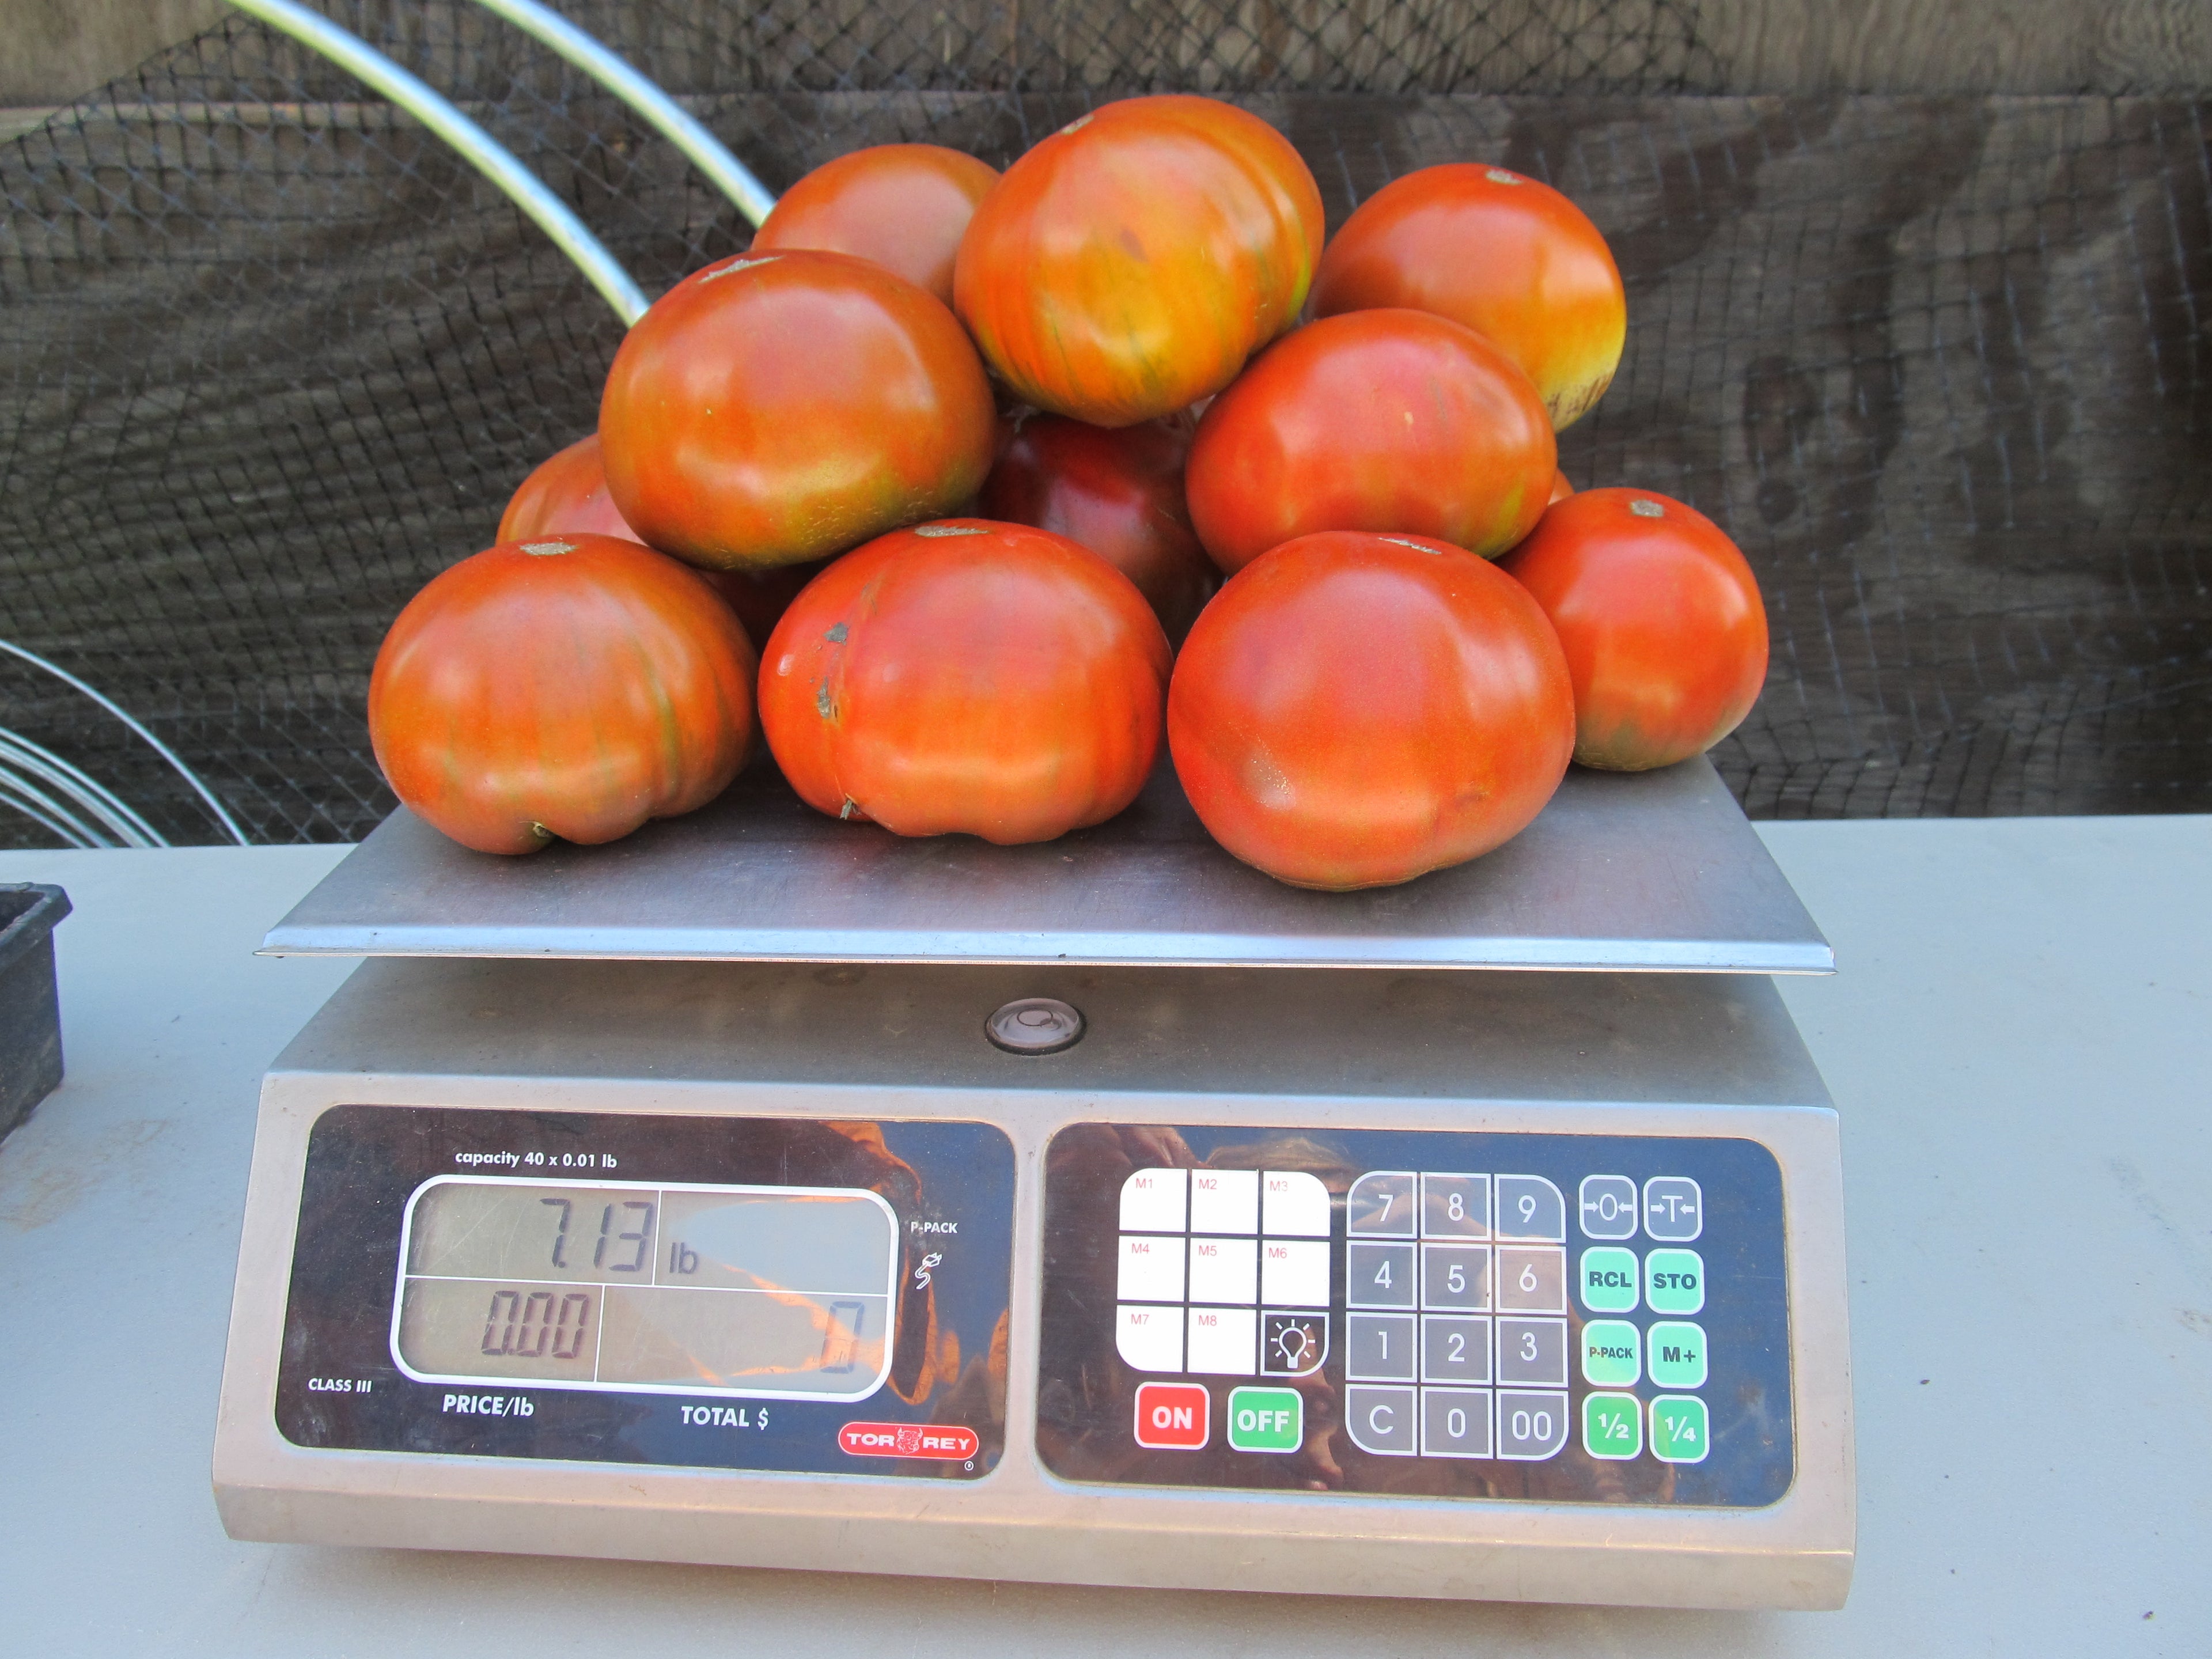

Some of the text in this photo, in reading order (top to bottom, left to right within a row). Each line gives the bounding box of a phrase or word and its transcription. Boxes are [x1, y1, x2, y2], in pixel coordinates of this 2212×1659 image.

[455, 1152, 618, 1168] capacity 40 x 0.01 lb
[1135, 1177, 1153, 1189] M1
[1199, 1179, 1217, 1190] M2
[1270, 1181, 1288, 1192] M3
[1378, 1194, 1393, 1222] 7
[1448, 1194, 1464, 1221] 8
[1518, 1195, 1536, 1223] 9
[540, 1198, 699, 1274] 7.13 lb
[911, 1222, 958, 1233] P-PACK
[1131, 1243, 1150, 1254] M4
[1199, 1245, 1217, 1257] M5
[1268, 1248, 1287, 1259] M6
[1374, 1260, 1392, 1288] 4
[1448, 1265, 1465, 1293] 5
[1520, 1264, 1537, 1291] 6
[1589, 1272, 1631, 1288] RCL
[1654, 1274, 1697, 1289] STO
[1131, 1314, 1149, 1325] M7
[1198, 1315, 1217, 1326] M8
[820, 1301, 864, 1374] 0
[1378, 1331, 1388, 1359] 1
[1448, 1333, 1464, 1361] 2
[1521, 1332, 1537, 1360] 3
[1589, 1347, 1633, 1359] P-PACK
[308, 1378, 372, 1392] CLASS III
[442, 1393, 534, 1416] PRICE/lb
[681, 1406, 769, 1430] TOTAL $
[1152, 1406, 1192, 1429] ON
[1237, 1410, 1290, 1433] OFF
[1369, 1404, 1393, 1434] C
[1448, 1408, 1465, 1437] 0
[1512, 1410, 1552, 1441] 00
